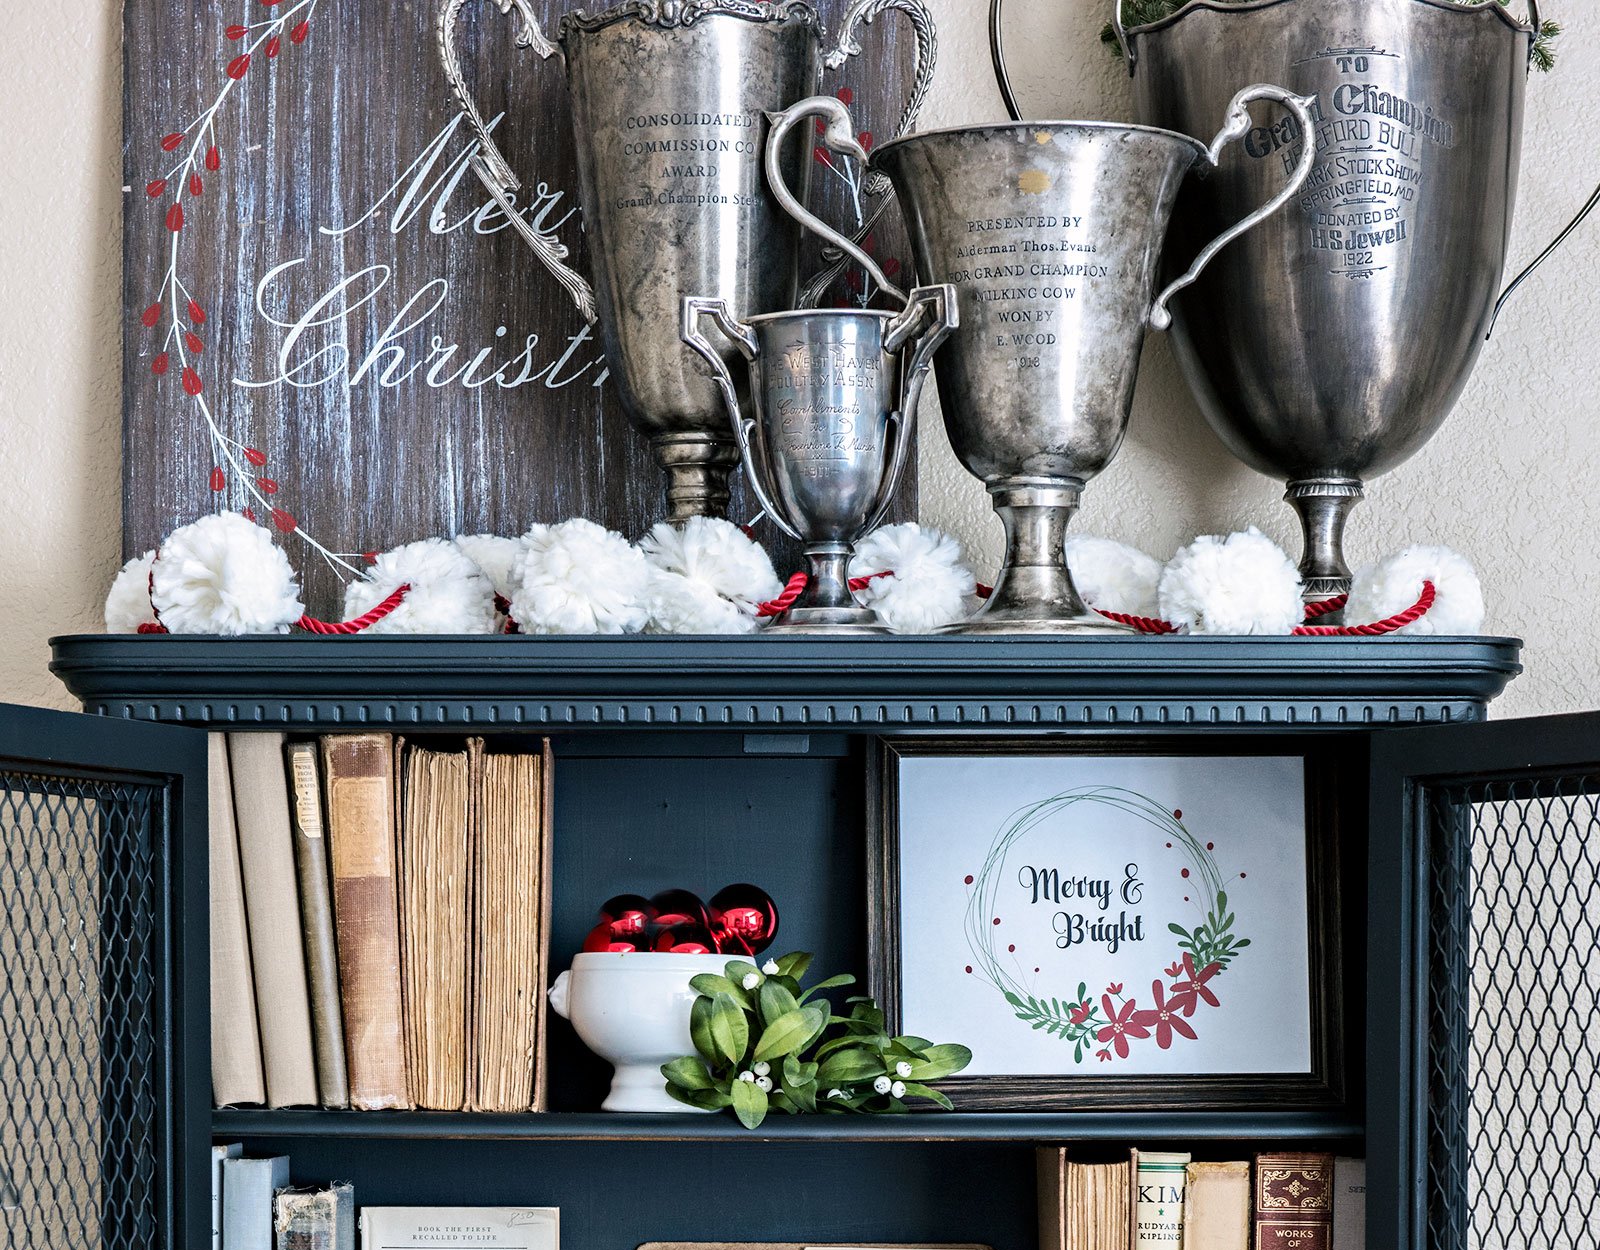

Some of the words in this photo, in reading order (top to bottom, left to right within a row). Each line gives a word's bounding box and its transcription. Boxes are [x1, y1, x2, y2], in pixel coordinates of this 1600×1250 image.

[1336, 56, 1369, 74] TO
[626, 112, 753, 130] CONSOLIDATED
[1245, 91, 1327, 158] Grad
[1333, 83, 1454, 149] Champion
[624, 139, 730, 156] COMMISSION
[1281, 119, 1370, 175] HEEFORD
[1379, 121, 1419, 163] BULL
[660, 165, 718, 178] AWARD
[1335, 156, 1384, 177] STOCK
[1386, 158, 1423, 185] SHOW
[616, 192, 654, 210] Grand
[658, 192, 728, 207] Champion
[967, 216, 1058, 233] PRESENTED
[1062, 216, 1082, 228] BY
[1318, 210, 1382, 227] DONATED
[1385, 206, 1402, 219] BY
[1345, 219, 1407, 250] Jewell
[956, 242, 1017, 259] Alderman
[1343, 251, 1374, 266] 1922
[949, 270, 971, 283] FOR
[974, 265, 1025, 280] GRAND
[1030, 264, 1108, 278] CHAMPION
[976, 287, 1037, 303] MILKING
[1042, 287, 1076, 299] COW
[232, 258, 610, 389] Christ
[998, 310, 1031, 323] WON
[1035, 310, 1054, 322] BY
[996, 335, 1008, 347] E.
[1018, 865, 1114, 910] Merry
[1120, 863, 1144, 905] &
[1052, 911, 1145, 954] Bright
[1137, 1185, 1185, 1203] KIM
[1138, 1222, 1184, 1230] RUDYARD
[1275, 1229, 1314, 1238] WORKS
[1140, 1232, 1181, 1240] KIPLING
[1288, 1239, 1301, 1248] OF
